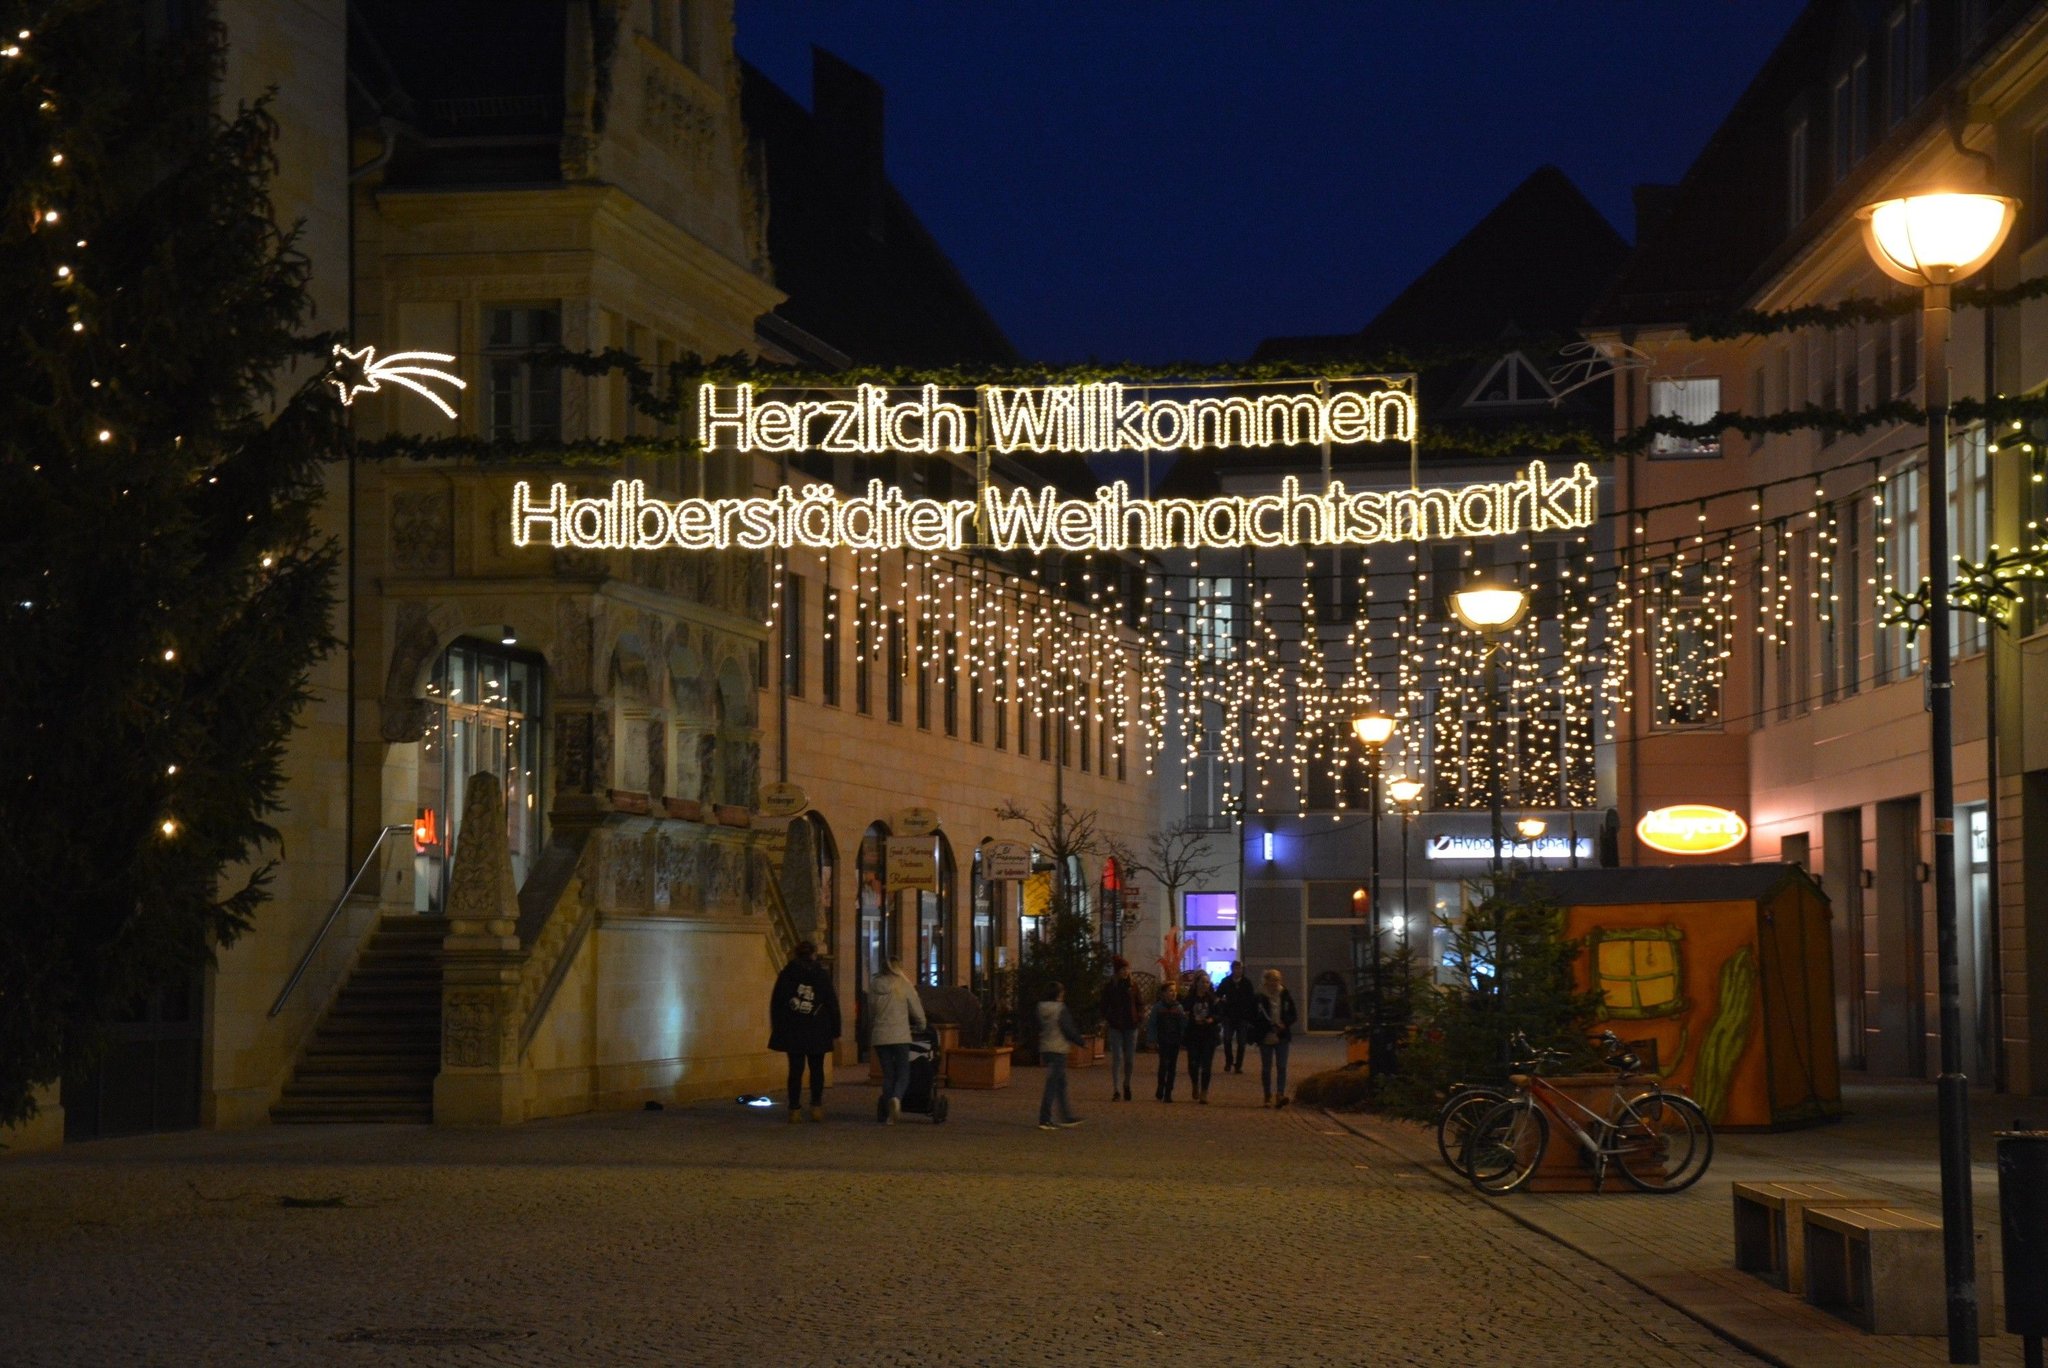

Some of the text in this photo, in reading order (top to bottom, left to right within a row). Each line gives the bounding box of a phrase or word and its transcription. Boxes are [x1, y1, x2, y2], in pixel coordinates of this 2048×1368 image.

[698, 381, 1416, 454] Herzlich Willkommen
[511, 459, 1598, 552] Halberstädter Weihnachtsmarkt
